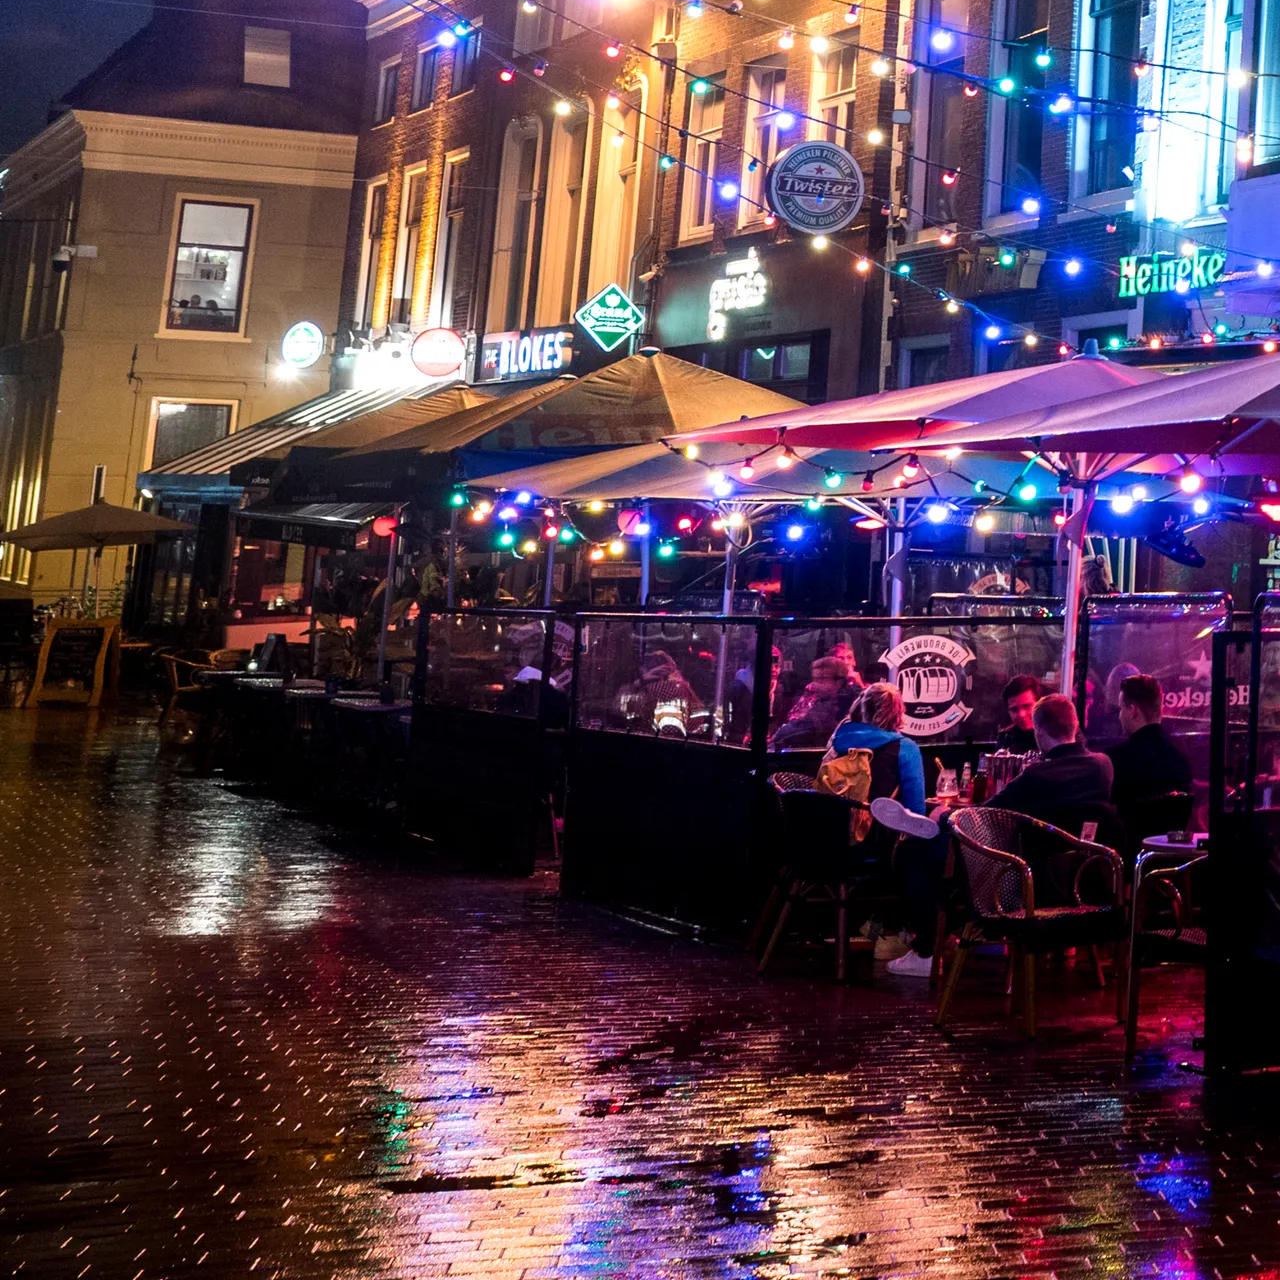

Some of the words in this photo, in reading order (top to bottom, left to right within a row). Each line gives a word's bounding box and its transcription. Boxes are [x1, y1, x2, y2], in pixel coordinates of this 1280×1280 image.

[787, 148, 821, 170] HEINEKEN
[784, 177, 853, 196] Twister
[785, 200, 818, 226] PREMIUM
[818, 206, 848, 225] QUALITY
